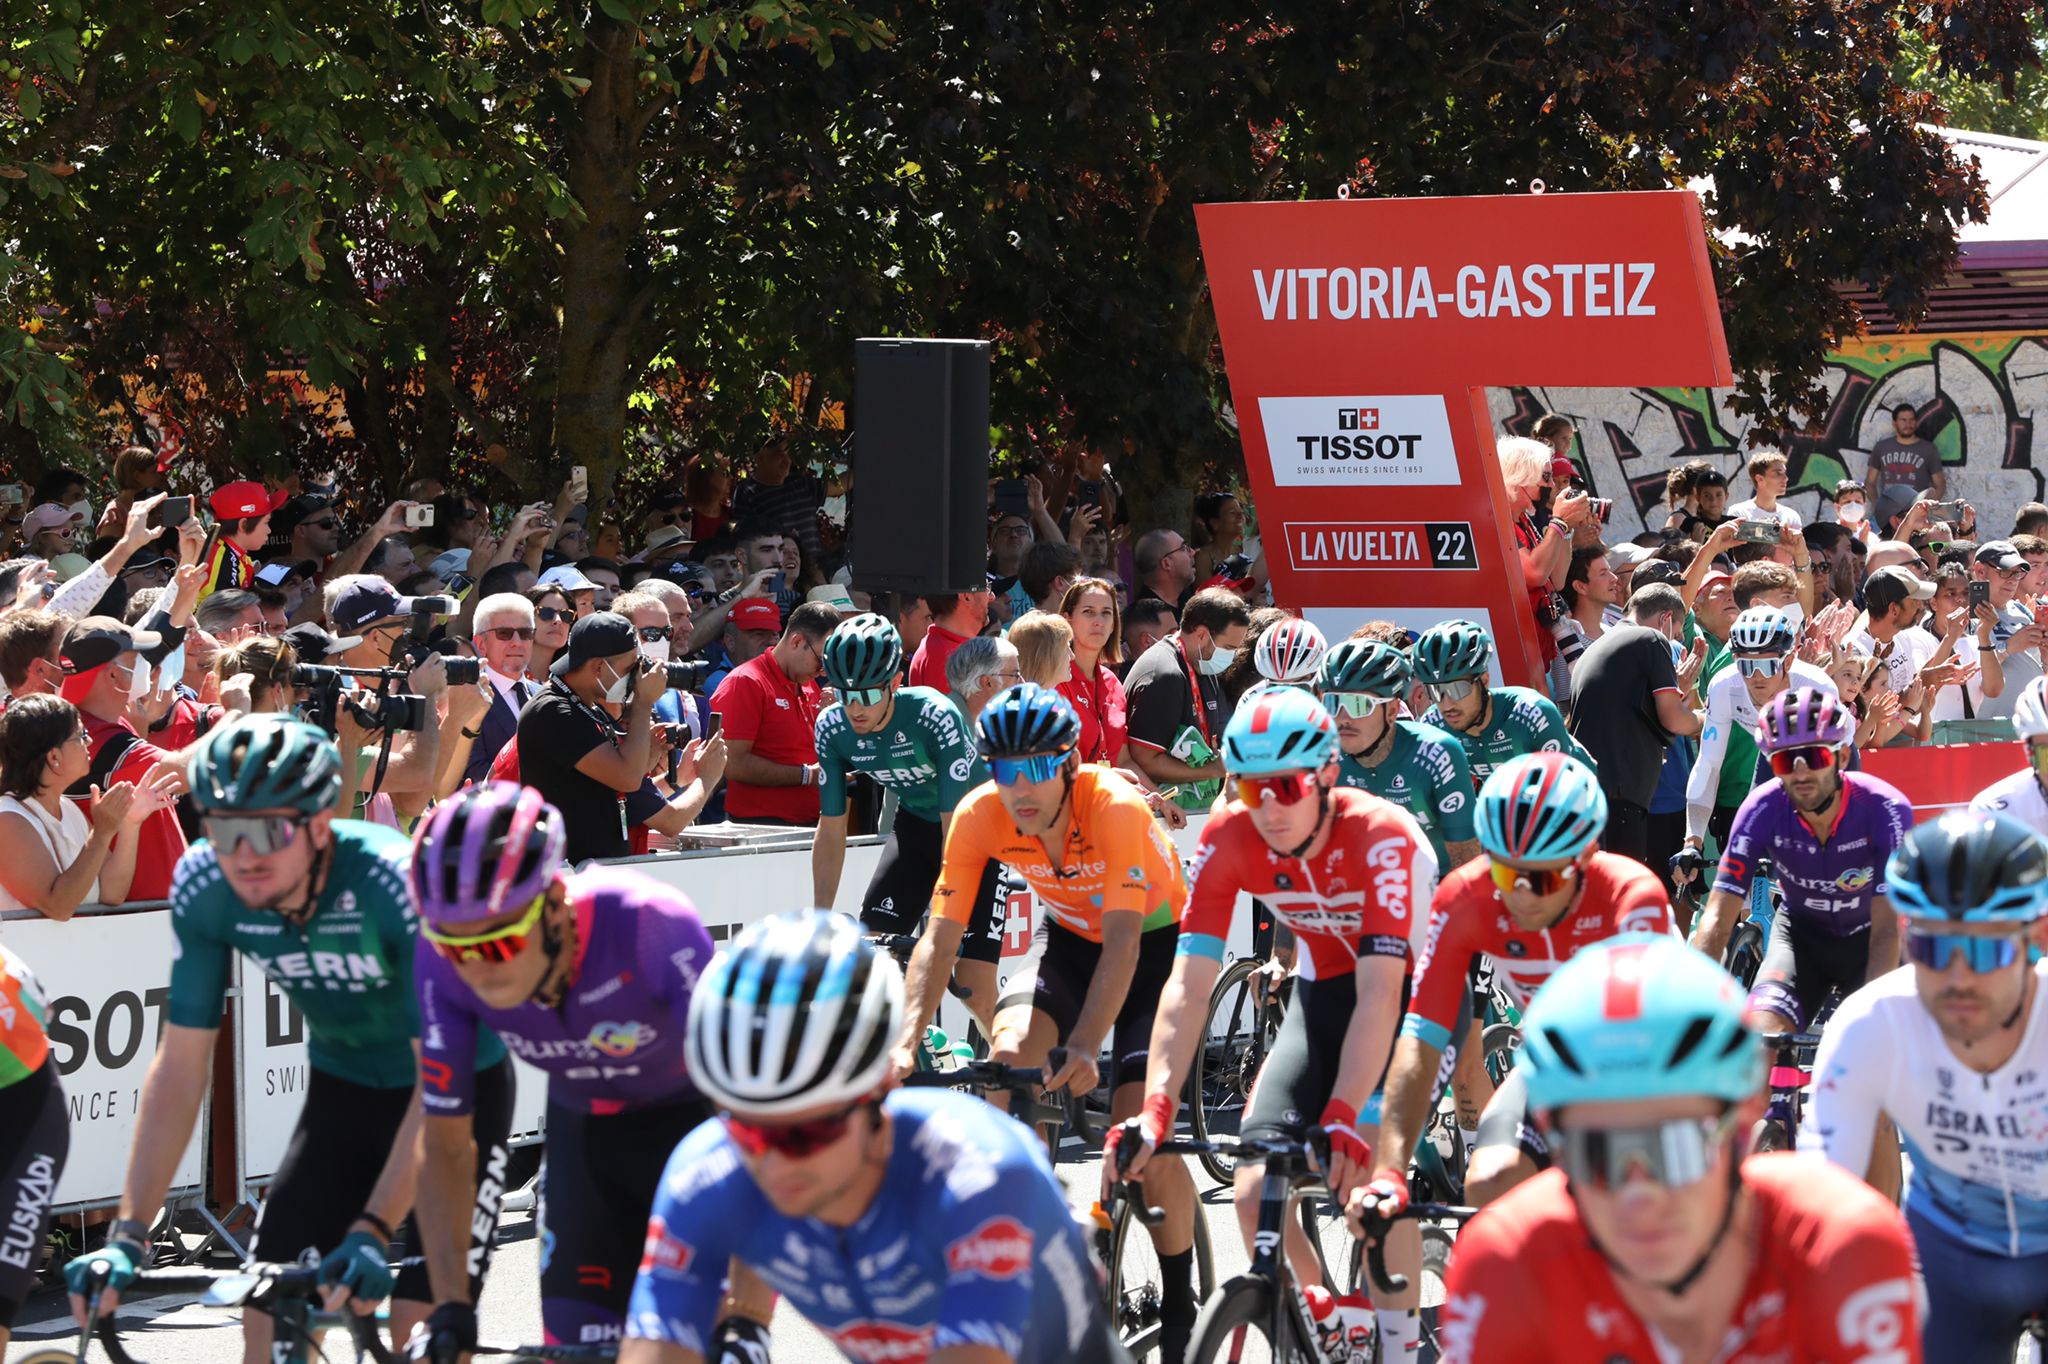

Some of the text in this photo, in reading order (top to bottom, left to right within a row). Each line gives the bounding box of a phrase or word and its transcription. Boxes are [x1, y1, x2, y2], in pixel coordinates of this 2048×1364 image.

[1252, 262, 1656, 320] VITORIA-GASTEIZ
[1297, 435, 1422, 460] TISSOT
[1881, 452, 1924, 469] TORONTO
[1297, 465, 1423, 474] SWISS WATCHES SINCE 1853
[1301, 531, 1466, 561] LA VUELTA 22
[920, 702, 961, 747] KERN
[1513, 701, 1549, 734] KERN
[1417, 740, 1456, 785] KERN
[986, 863, 1009, 942] KERN
[1804, 896, 1860, 912] BH
[1475, 955, 1494, 994] KE
[266, 1065, 304, 1096] SWI
[70, 1089, 117, 1122] NCE
[1927, 1102, 2023, 1138] ISRAEL
